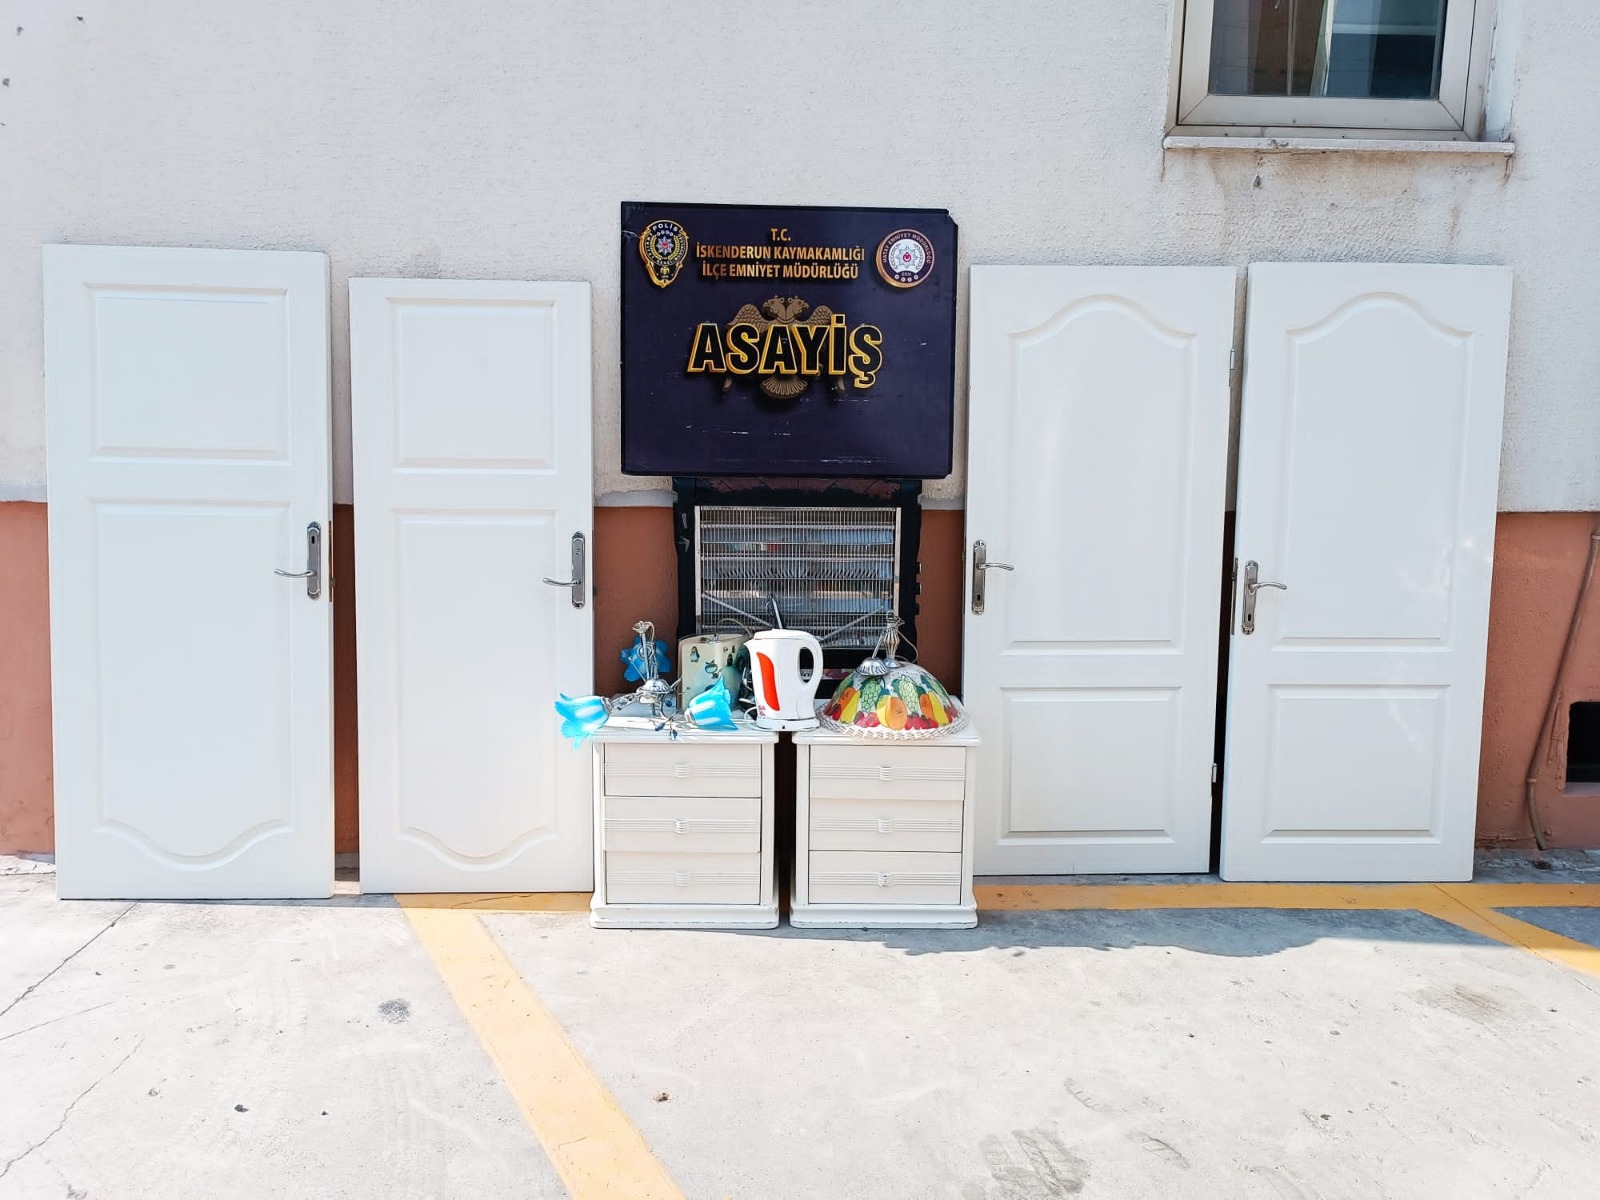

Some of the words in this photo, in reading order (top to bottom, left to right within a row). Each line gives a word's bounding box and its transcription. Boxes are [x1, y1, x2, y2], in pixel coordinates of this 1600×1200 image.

[771, 228, 791, 241] T.C.
[696, 241, 771, 259] İSKENDERUN
[774, 245, 865, 261] KAYMAKAMLIĞI
[702, 260, 727, 280] İLÇE
[729, 261, 780, 278] EMNİYET
[783, 262, 859, 279] MÜDÜRLÜĞÜ
[687, 314, 882, 388] ASAYİŞ
